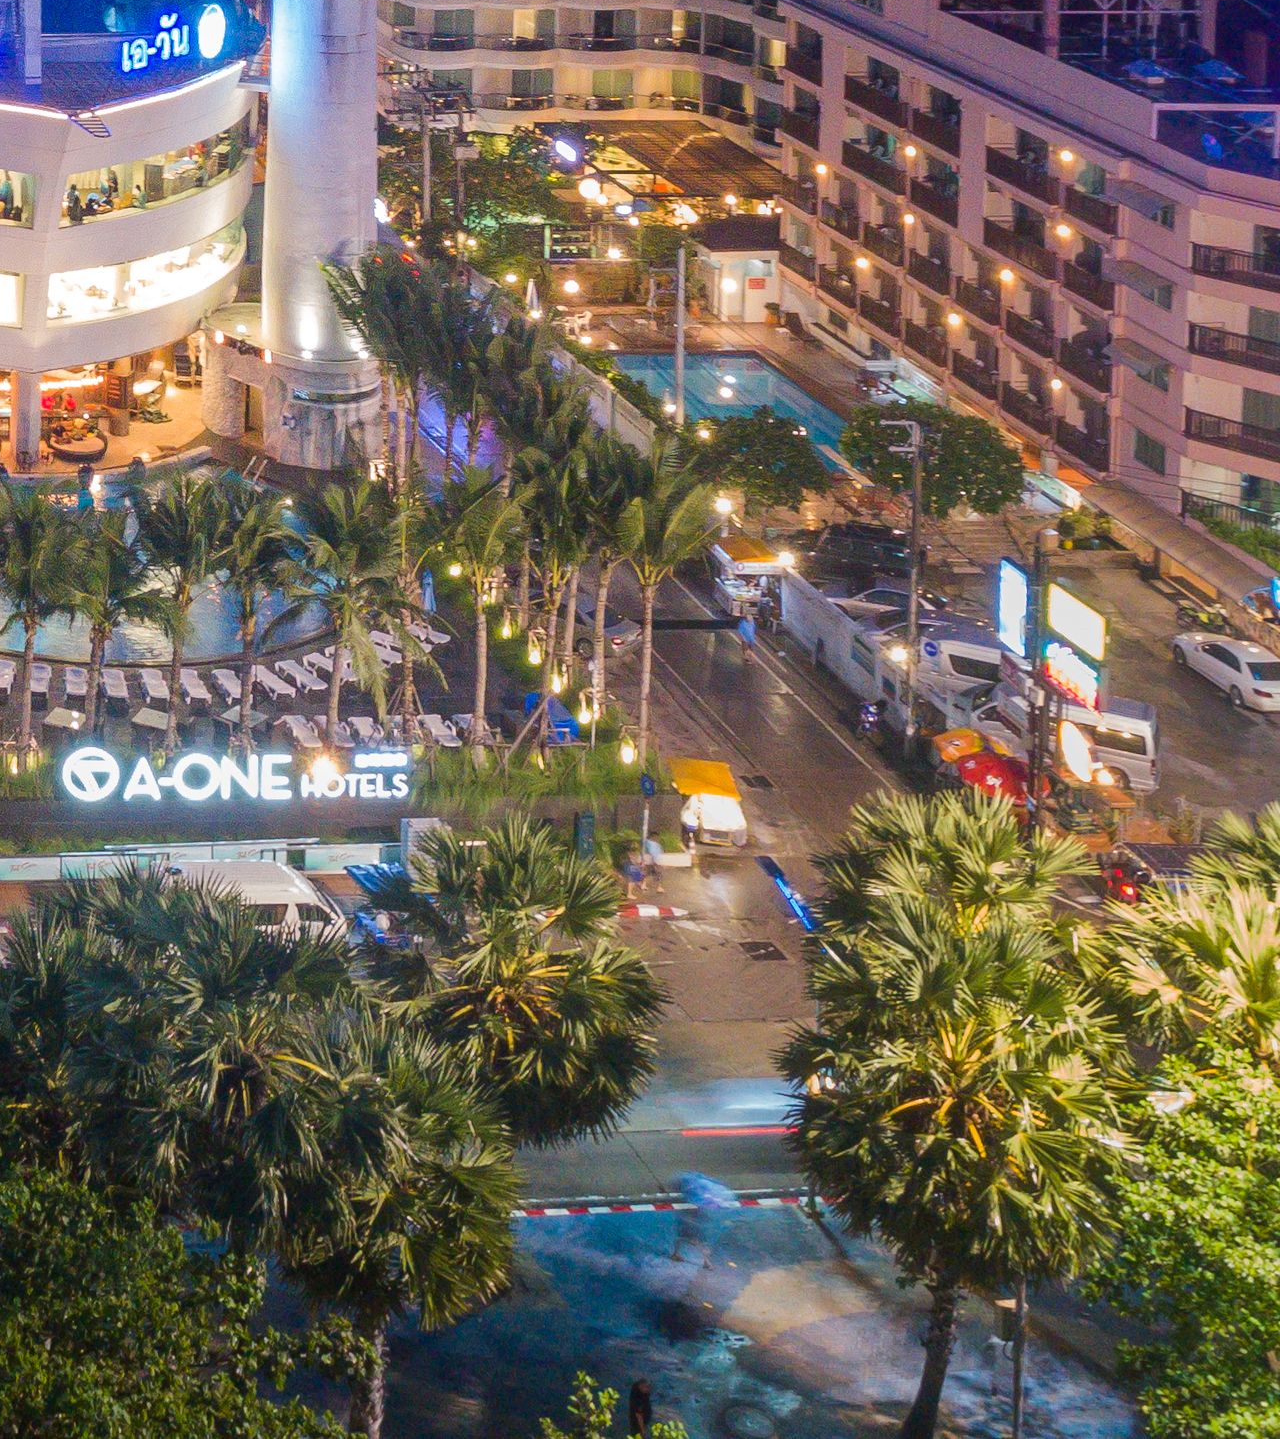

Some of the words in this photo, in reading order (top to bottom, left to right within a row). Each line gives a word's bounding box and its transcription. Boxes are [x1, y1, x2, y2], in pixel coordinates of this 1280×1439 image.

[121, 12, 190, 73] เอ-วัน
[122, 752, 292, 802] A-ONE
[300, 773, 409, 799] HOTELS
